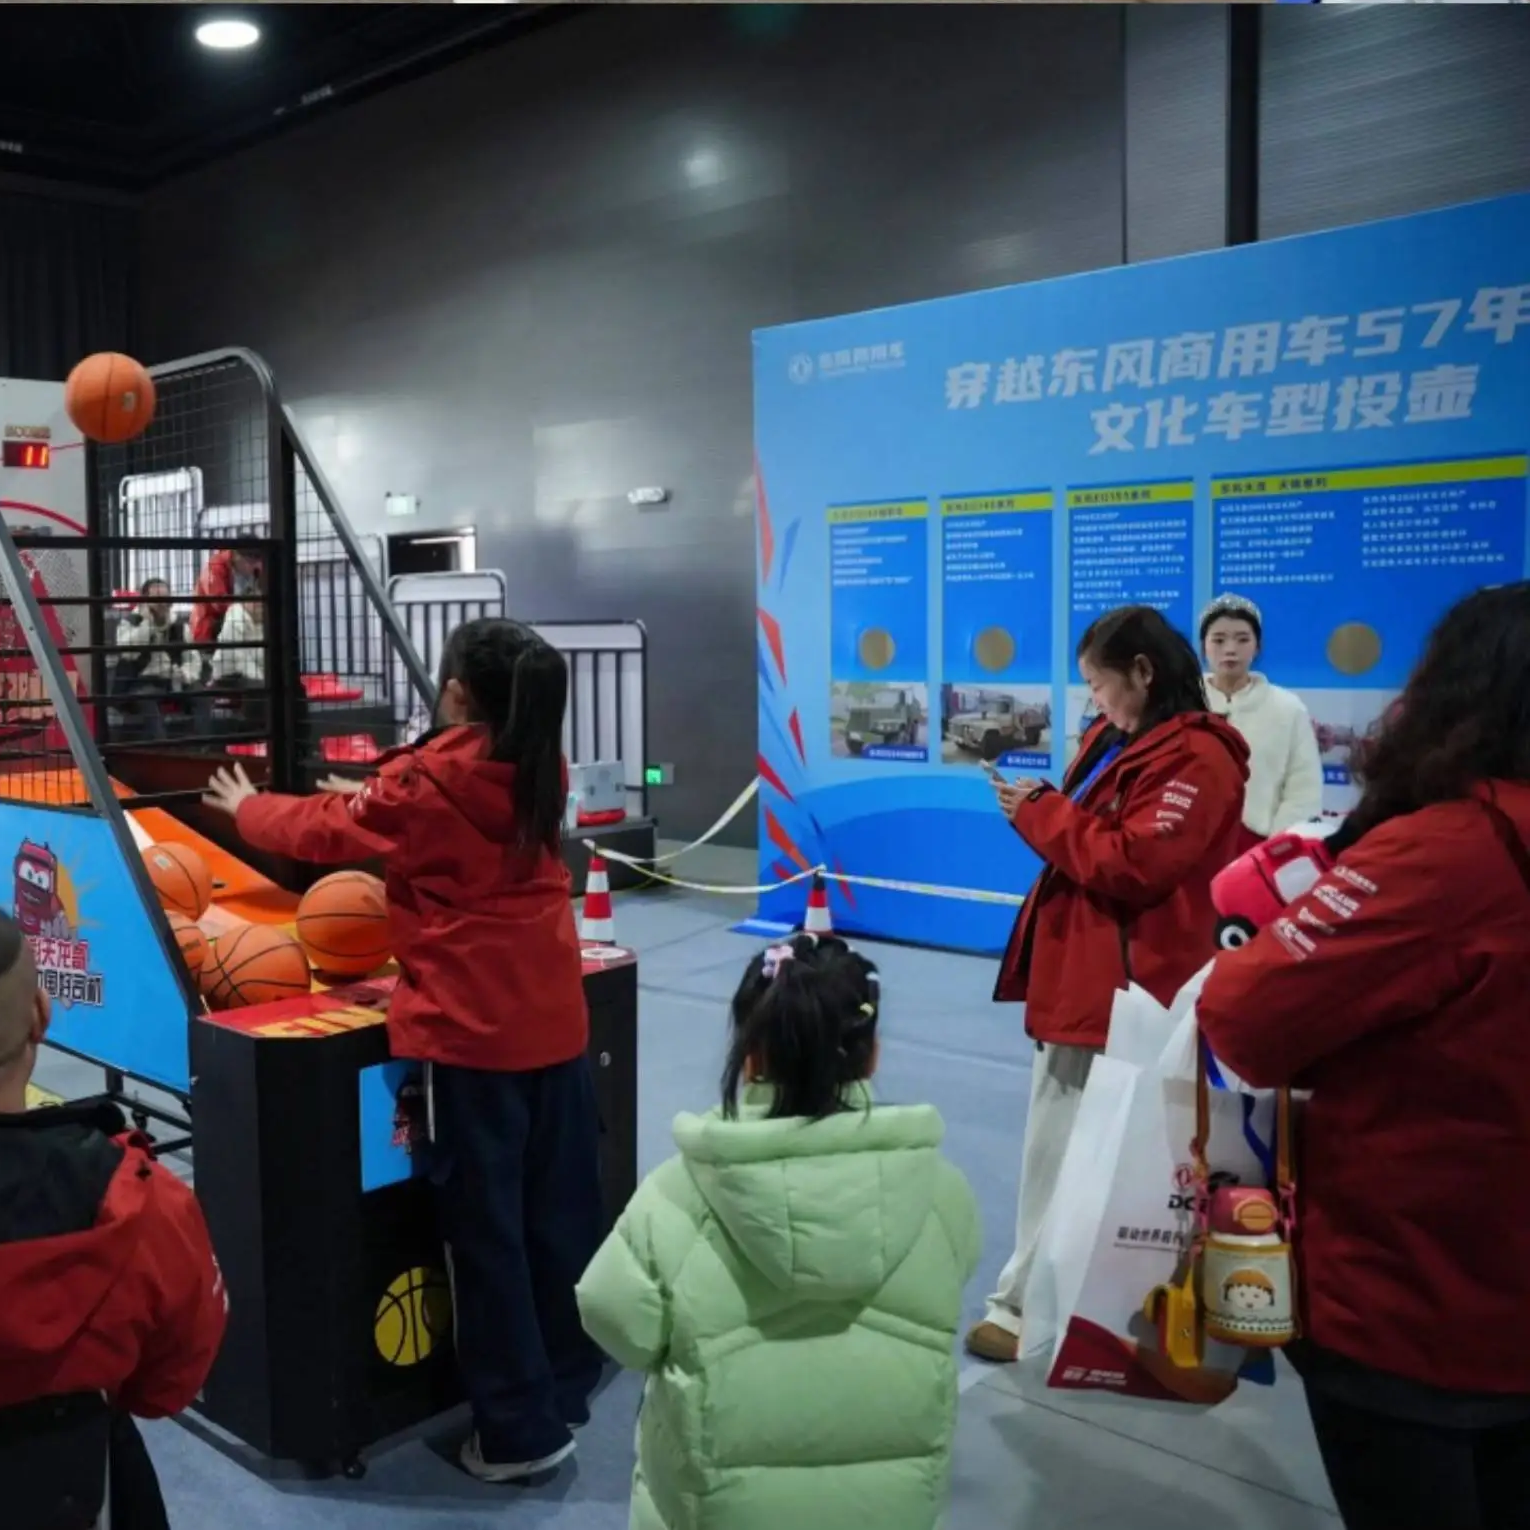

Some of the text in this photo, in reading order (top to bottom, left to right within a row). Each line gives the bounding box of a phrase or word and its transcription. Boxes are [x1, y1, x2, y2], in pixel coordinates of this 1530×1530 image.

[944, 282, 1530, 411] 穿越东风商用车57年
[1087, 363, 1481, 457] 文化车型投壶
